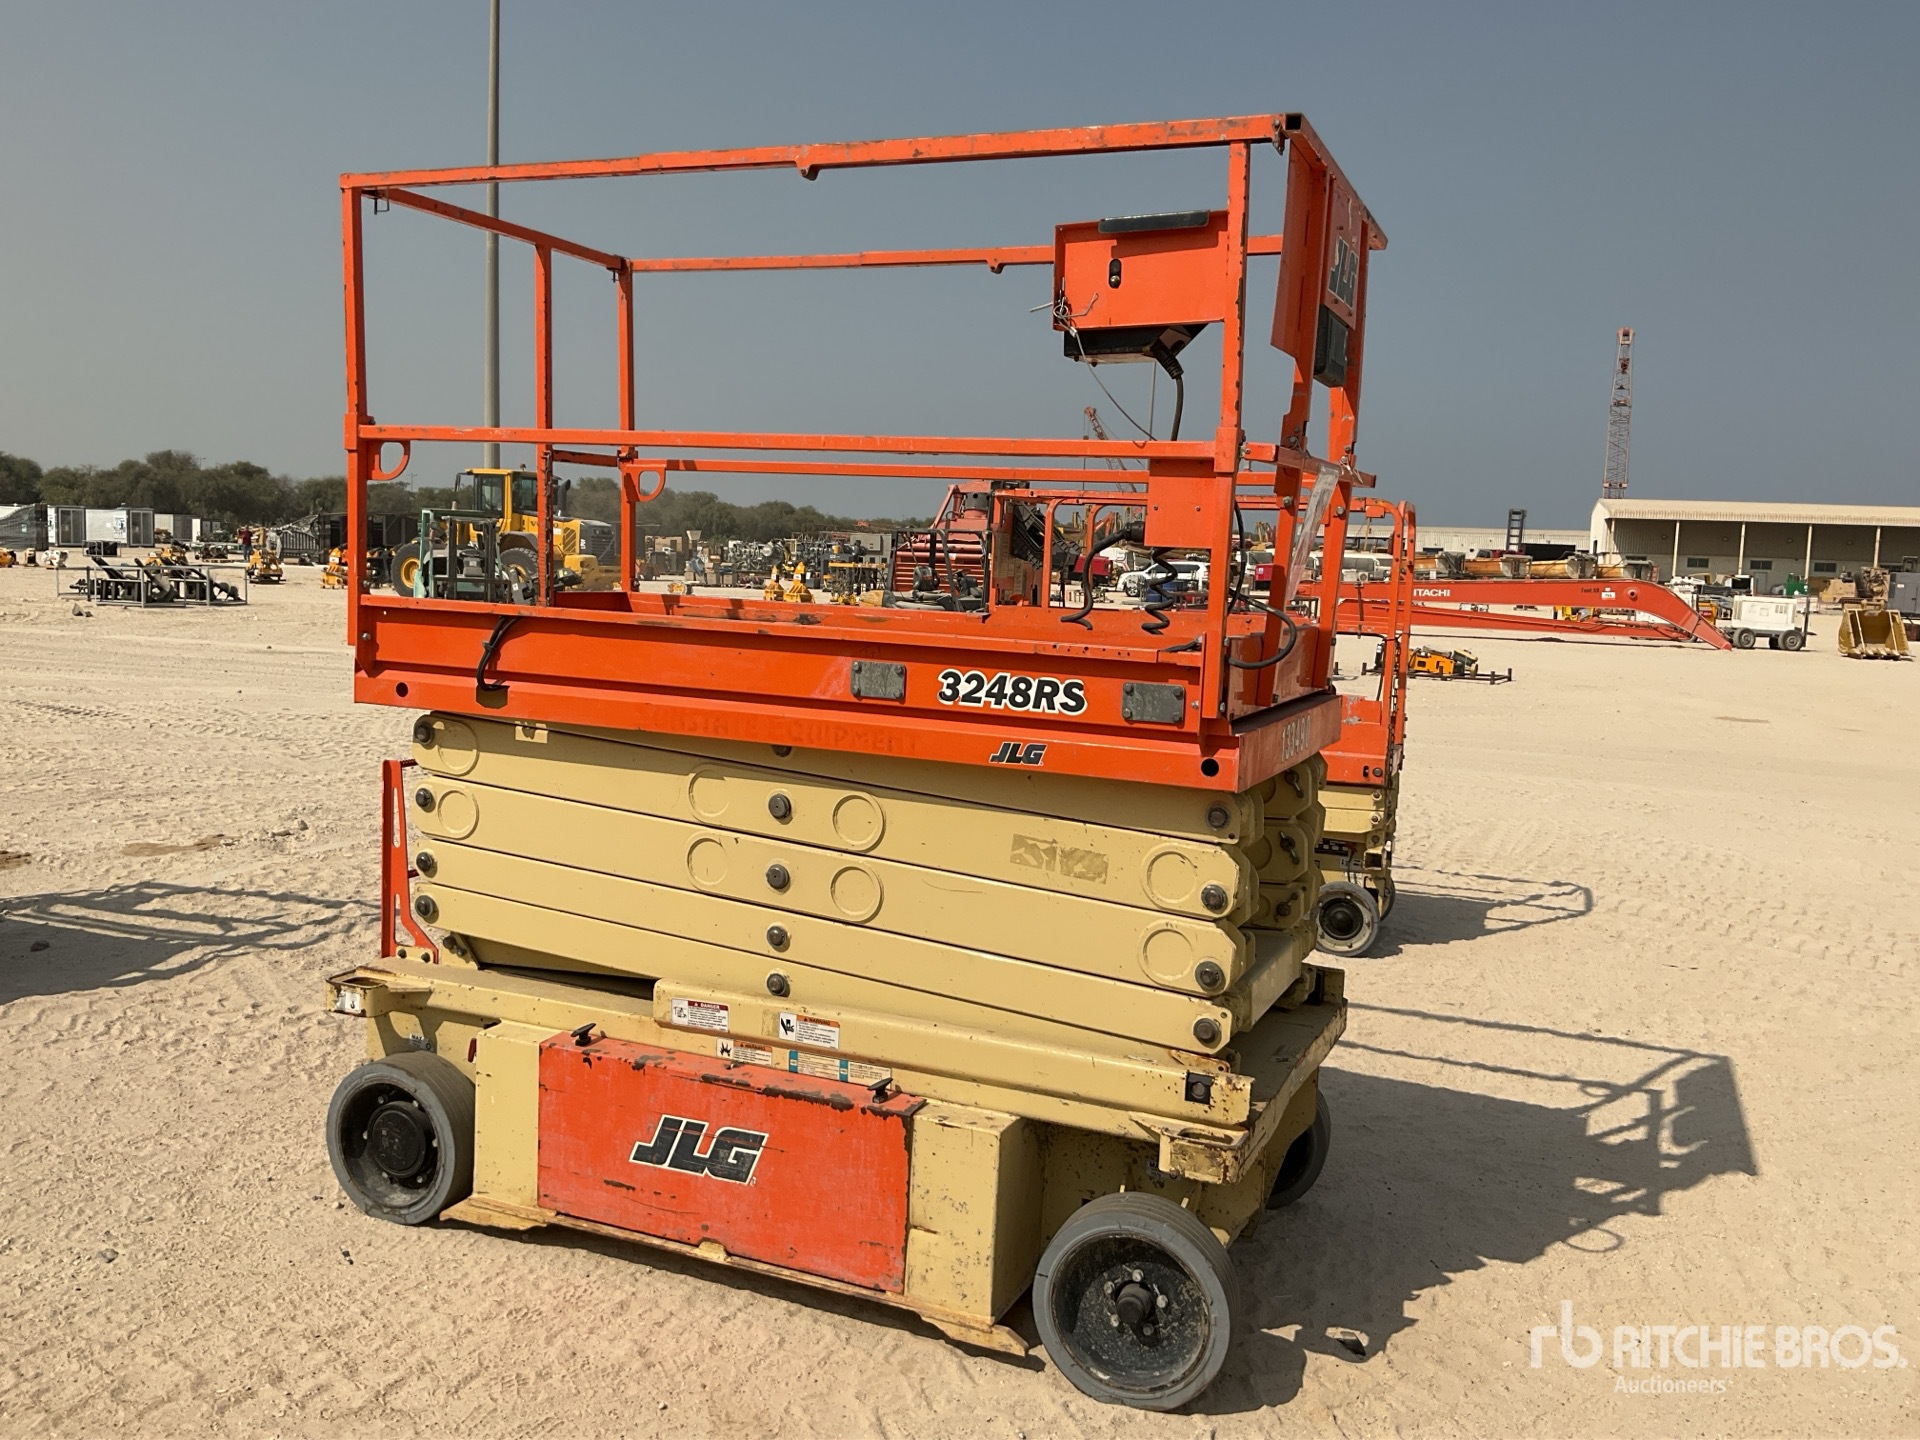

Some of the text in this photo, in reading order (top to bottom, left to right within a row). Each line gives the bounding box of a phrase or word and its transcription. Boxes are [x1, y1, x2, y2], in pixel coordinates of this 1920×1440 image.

[1328, 235, 1359, 310] JLG
[1413, 588, 1450, 597] ITACHI
[938, 669, 1087, 715] 3248RS
[989, 742, 1047, 766] JLG
[629, 1114, 769, 1185] JLG
